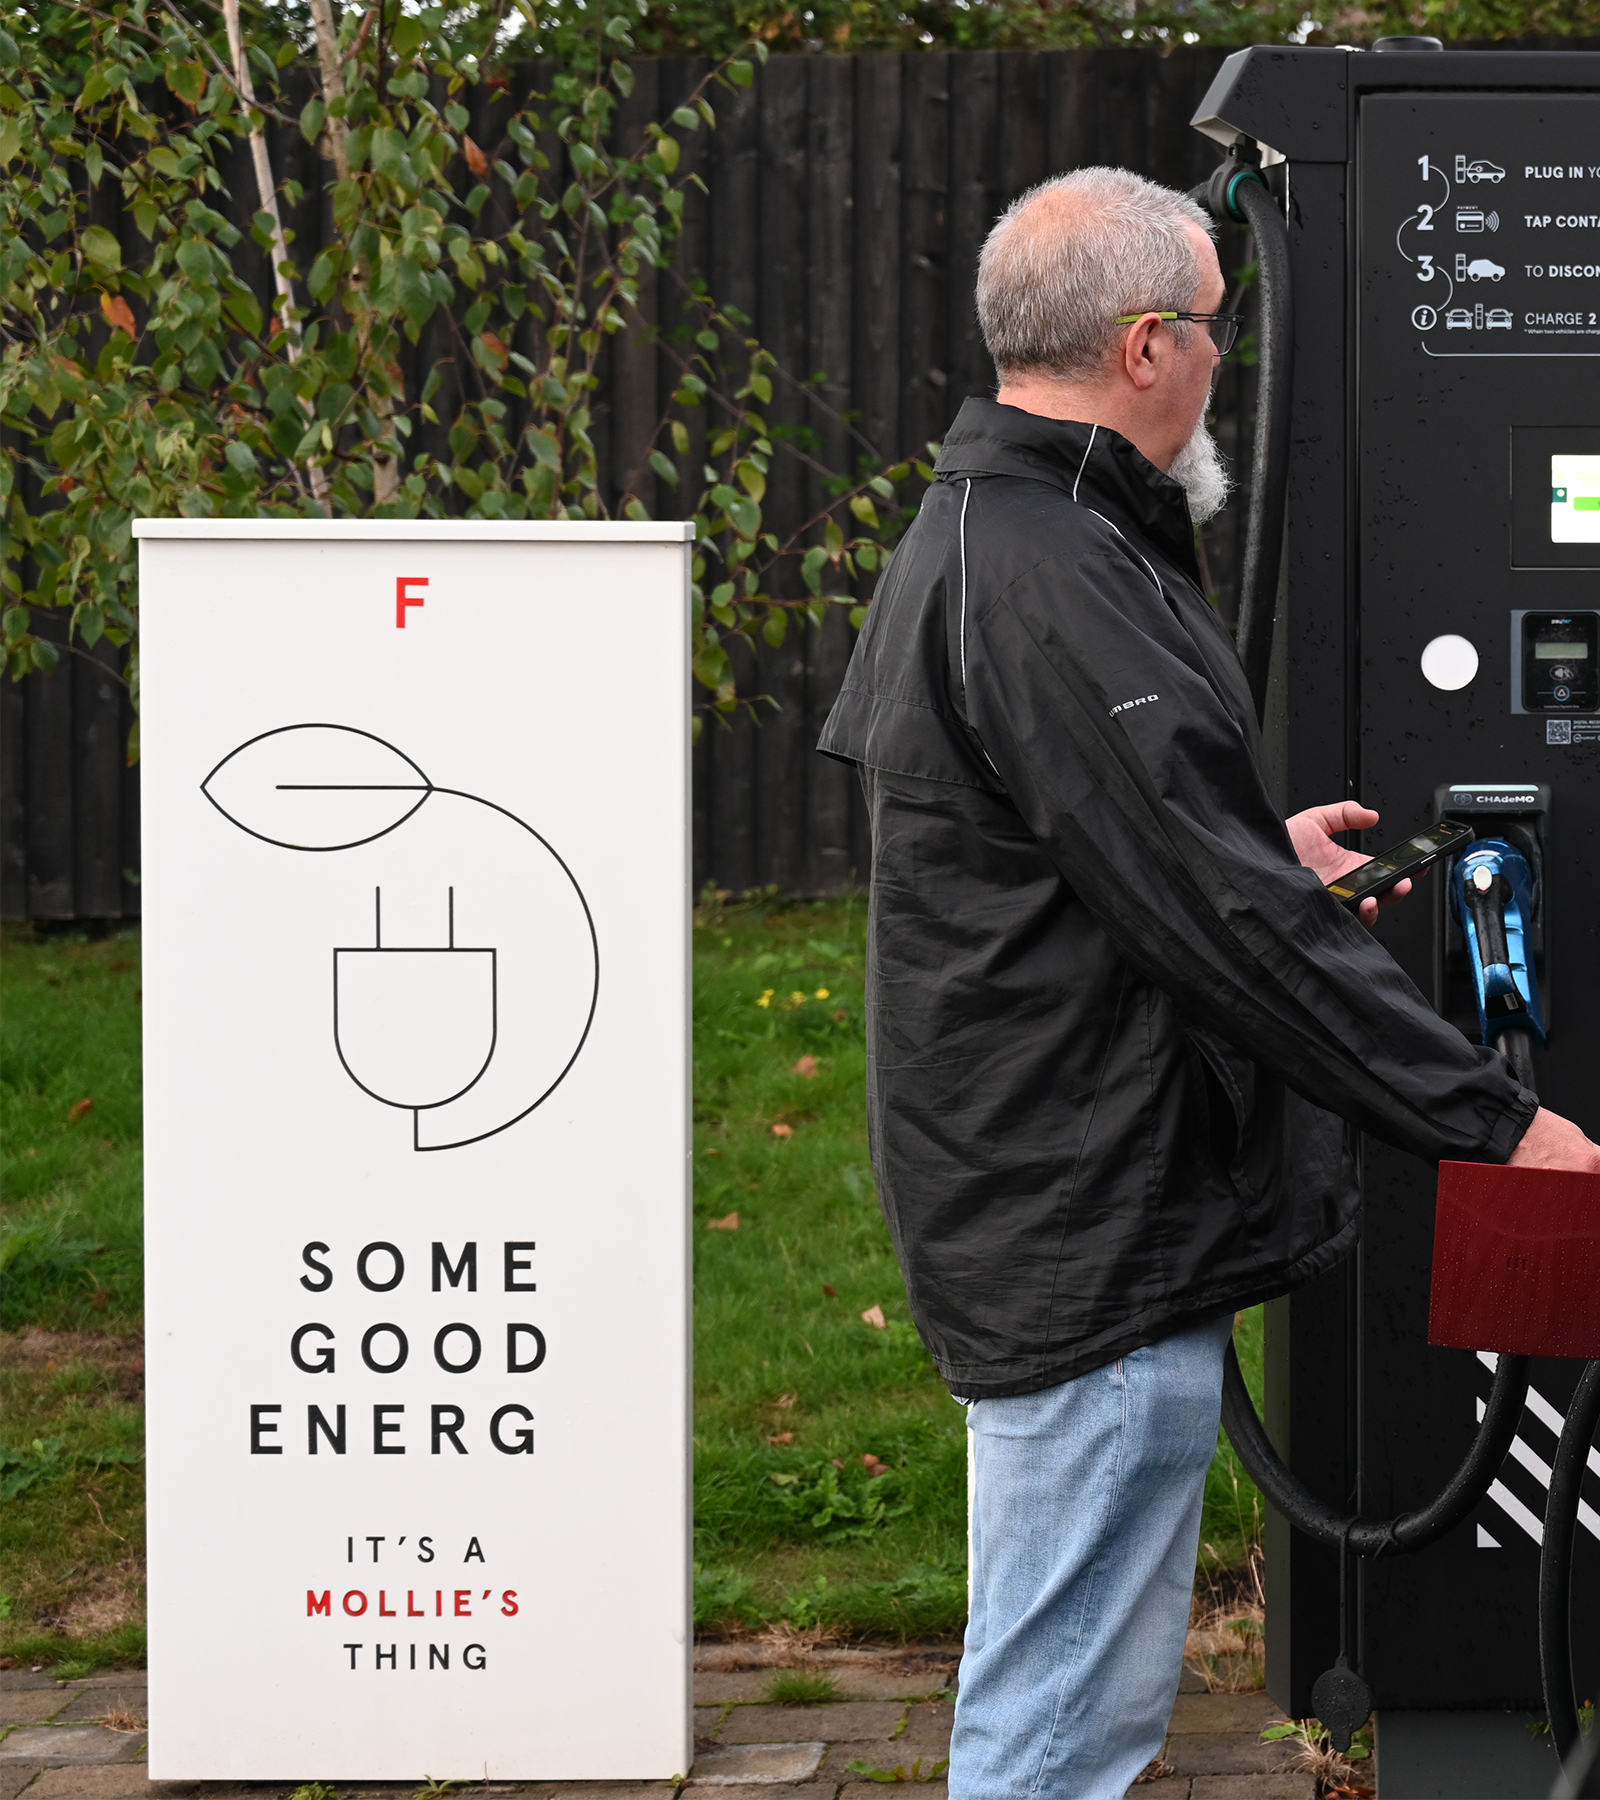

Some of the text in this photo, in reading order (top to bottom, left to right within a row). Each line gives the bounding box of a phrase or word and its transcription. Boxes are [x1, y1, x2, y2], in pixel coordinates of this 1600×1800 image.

[1417, 154, 1430, 181] 1
[1524, 166, 1564, 179] PLUG
[1568, 166, 1583, 179] IN
[1416, 204, 1434, 231] 2
[1524, 215, 1552, 228] TAP
[1416, 255, 1435, 282] 3
[1524, 265, 1544, 278] TO
[1524, 312, 1583, 325] CHARGE
[1588, 312, 1597, 325] 2
[395, 576, 430, 629] F
[1476, 795, 1535, 803] CHAdeMO
[299, 1240, 537, 1293] SOME
[290, 1322, 547, 1374] GOOD
[250, 1403, 535, 1456] ENERG
[347, 1536, 486, 1564] IT'S A
[306, 1589, 519, 1617] MOLLIE'S
[343, 1643, 487, 1671] THING
